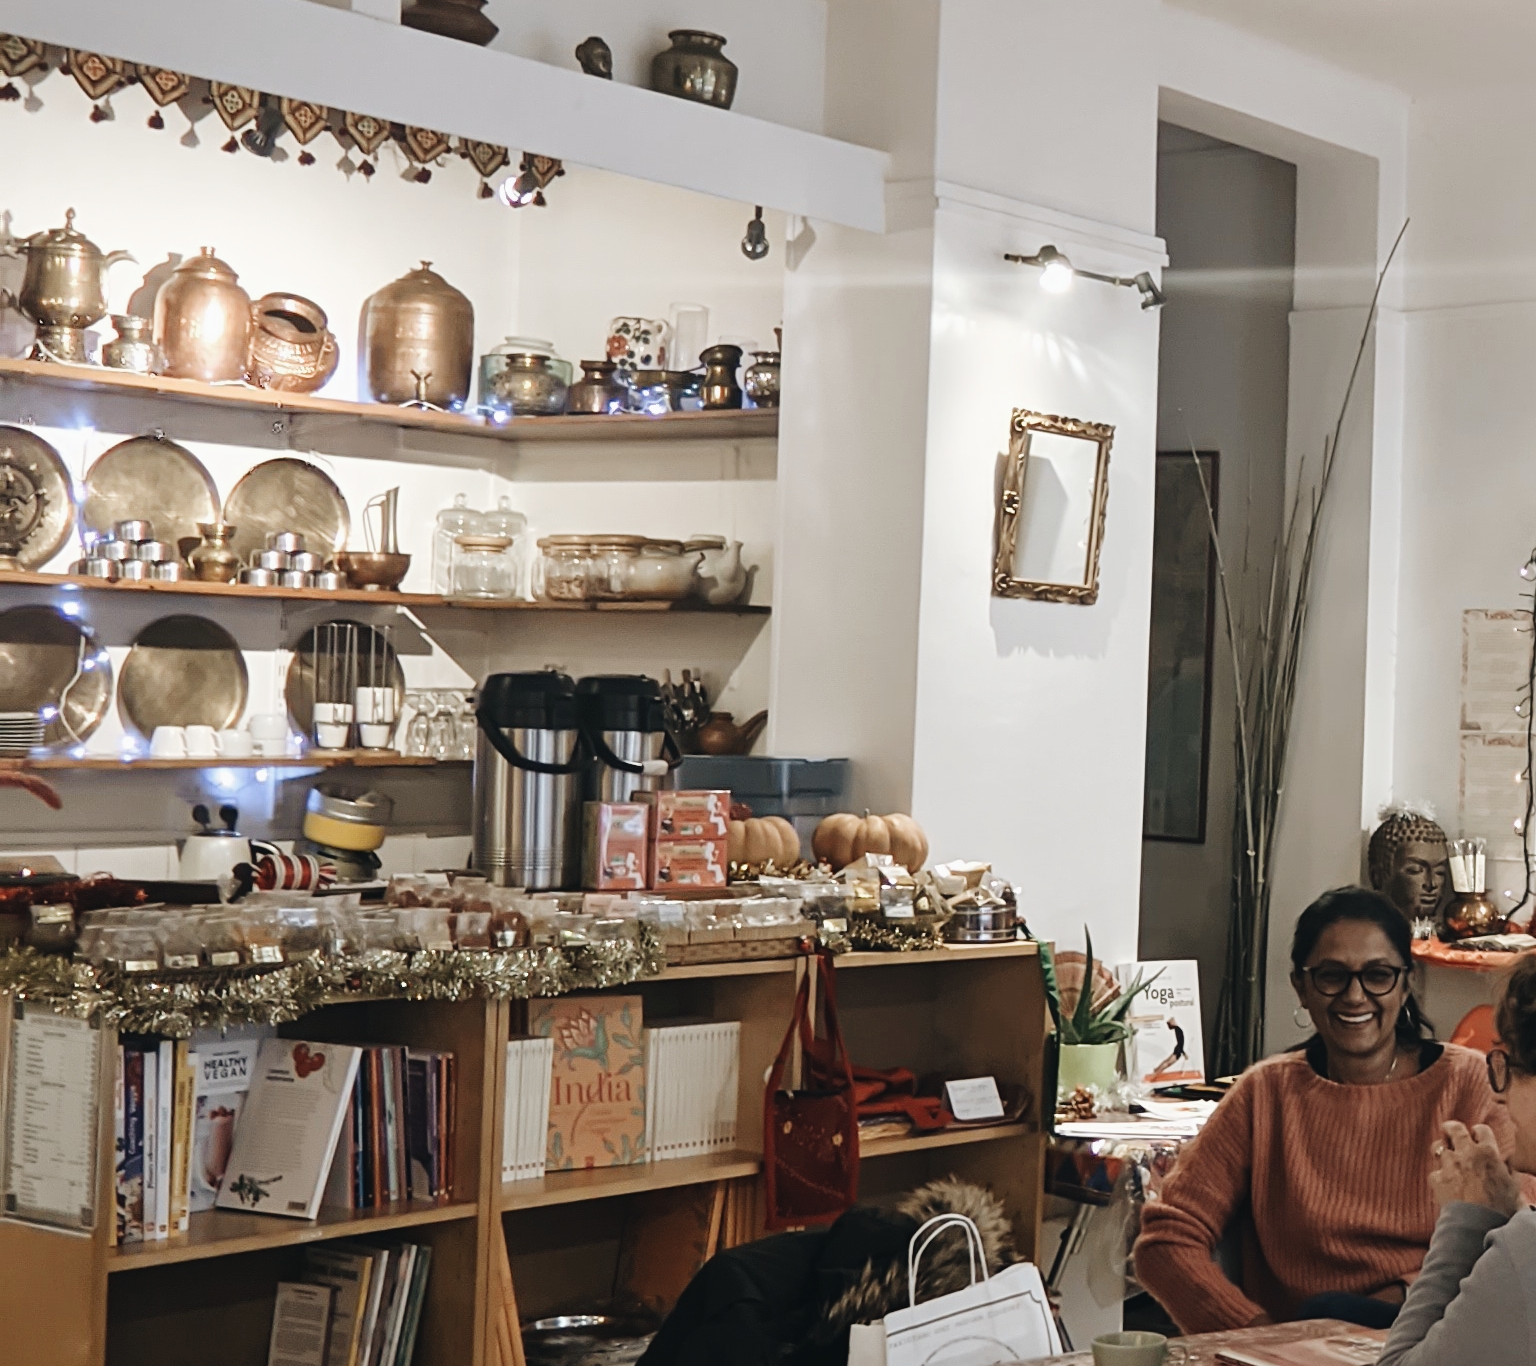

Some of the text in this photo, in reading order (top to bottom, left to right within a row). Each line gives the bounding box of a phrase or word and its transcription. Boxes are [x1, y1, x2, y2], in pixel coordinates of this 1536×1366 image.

[1143, 984, 1175, 1005] Yoga
[203, 1056, 248, 1070] HEALTHY
[203, 1067, 248, 1081] VEGAN
[554, 1071, 631, 1106] India
